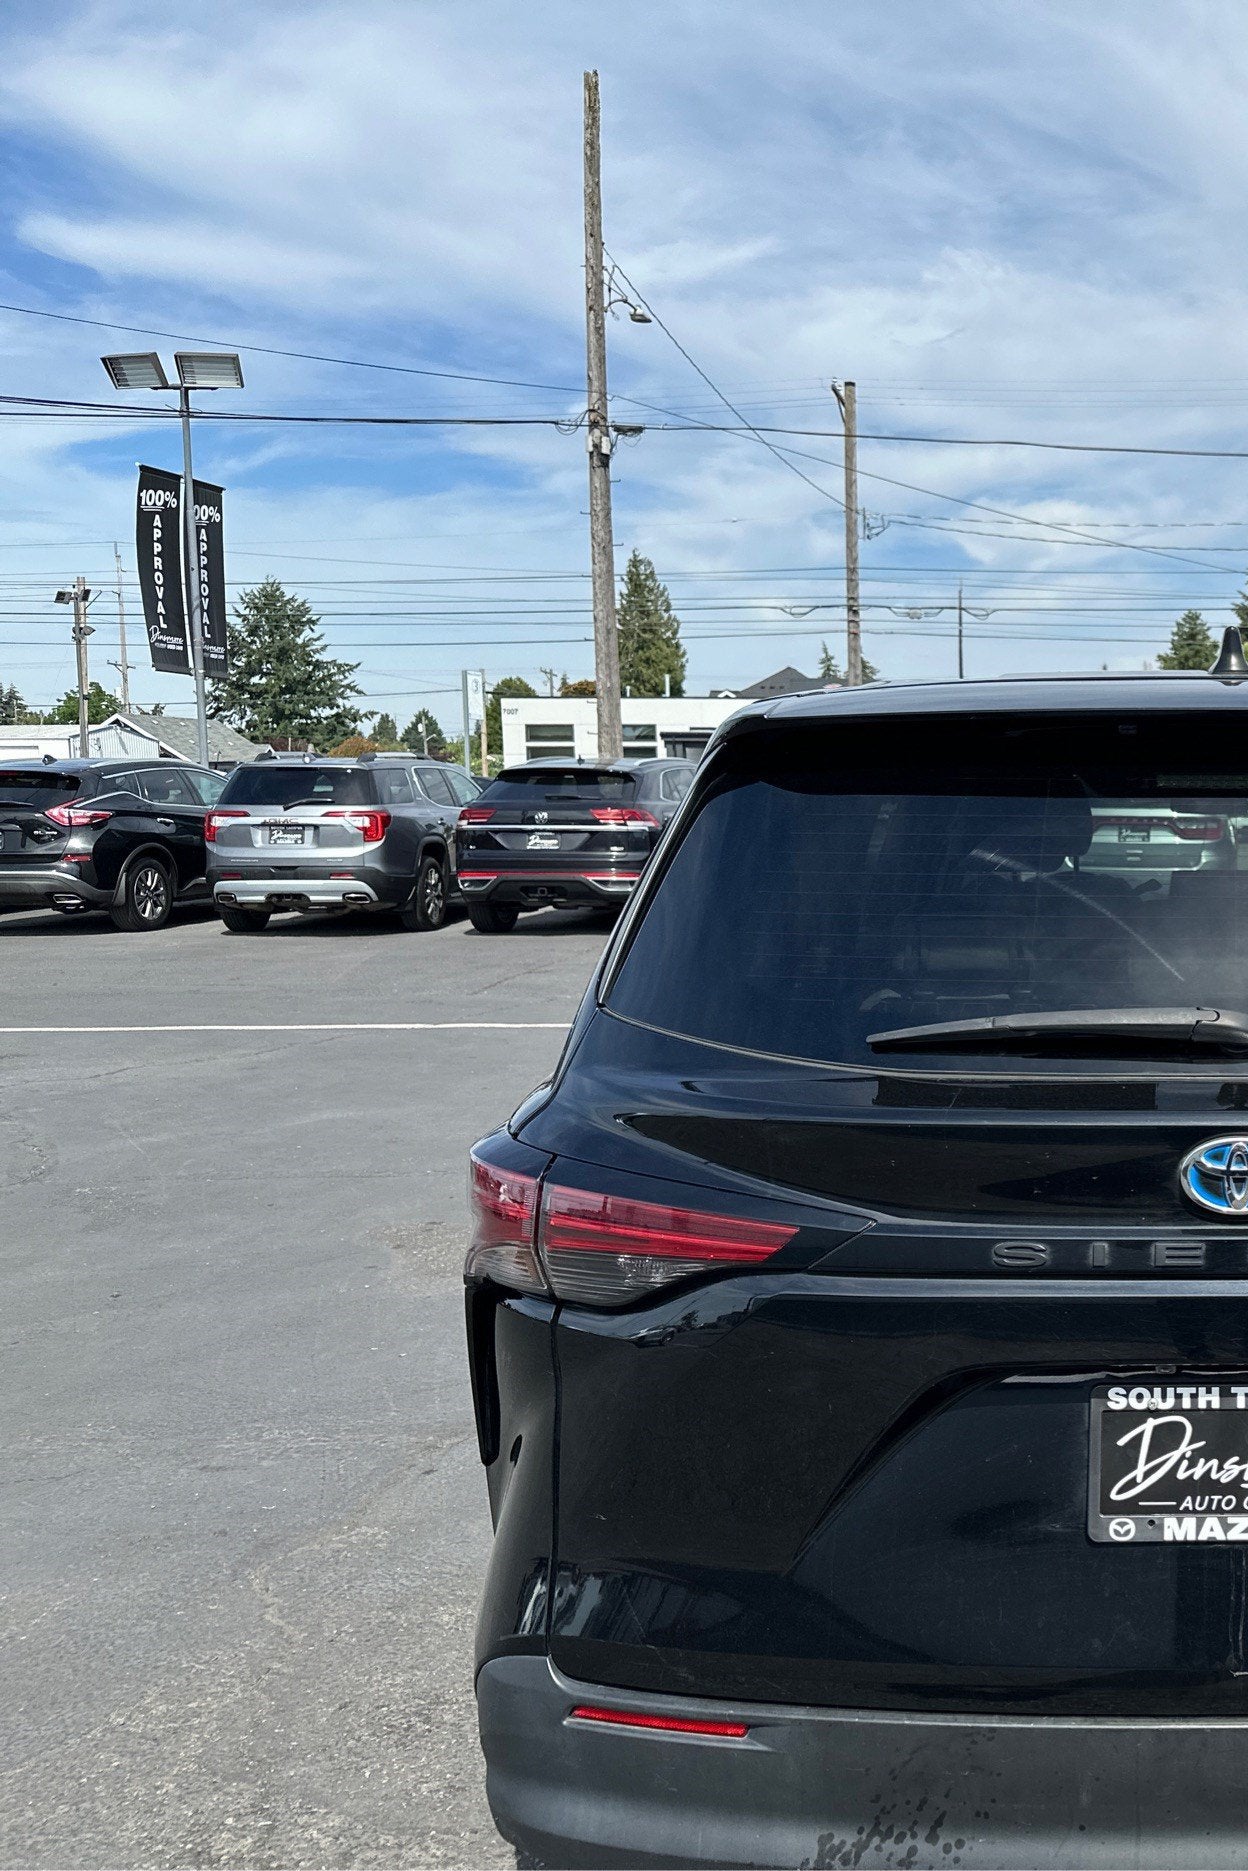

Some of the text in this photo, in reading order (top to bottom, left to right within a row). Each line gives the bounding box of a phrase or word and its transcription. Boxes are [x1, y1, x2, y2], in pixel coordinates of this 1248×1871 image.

[139, 489, 178, 509] 100%
[193, 504, 221, 523] 00%
[152, 514, 168, 629] APPROVAL
[199, 528, 212, 639] APPROVAL
[1106, 1386, 1220, 1411] SOUTH
[1179, 1494, 1236, 1512] AUTO
